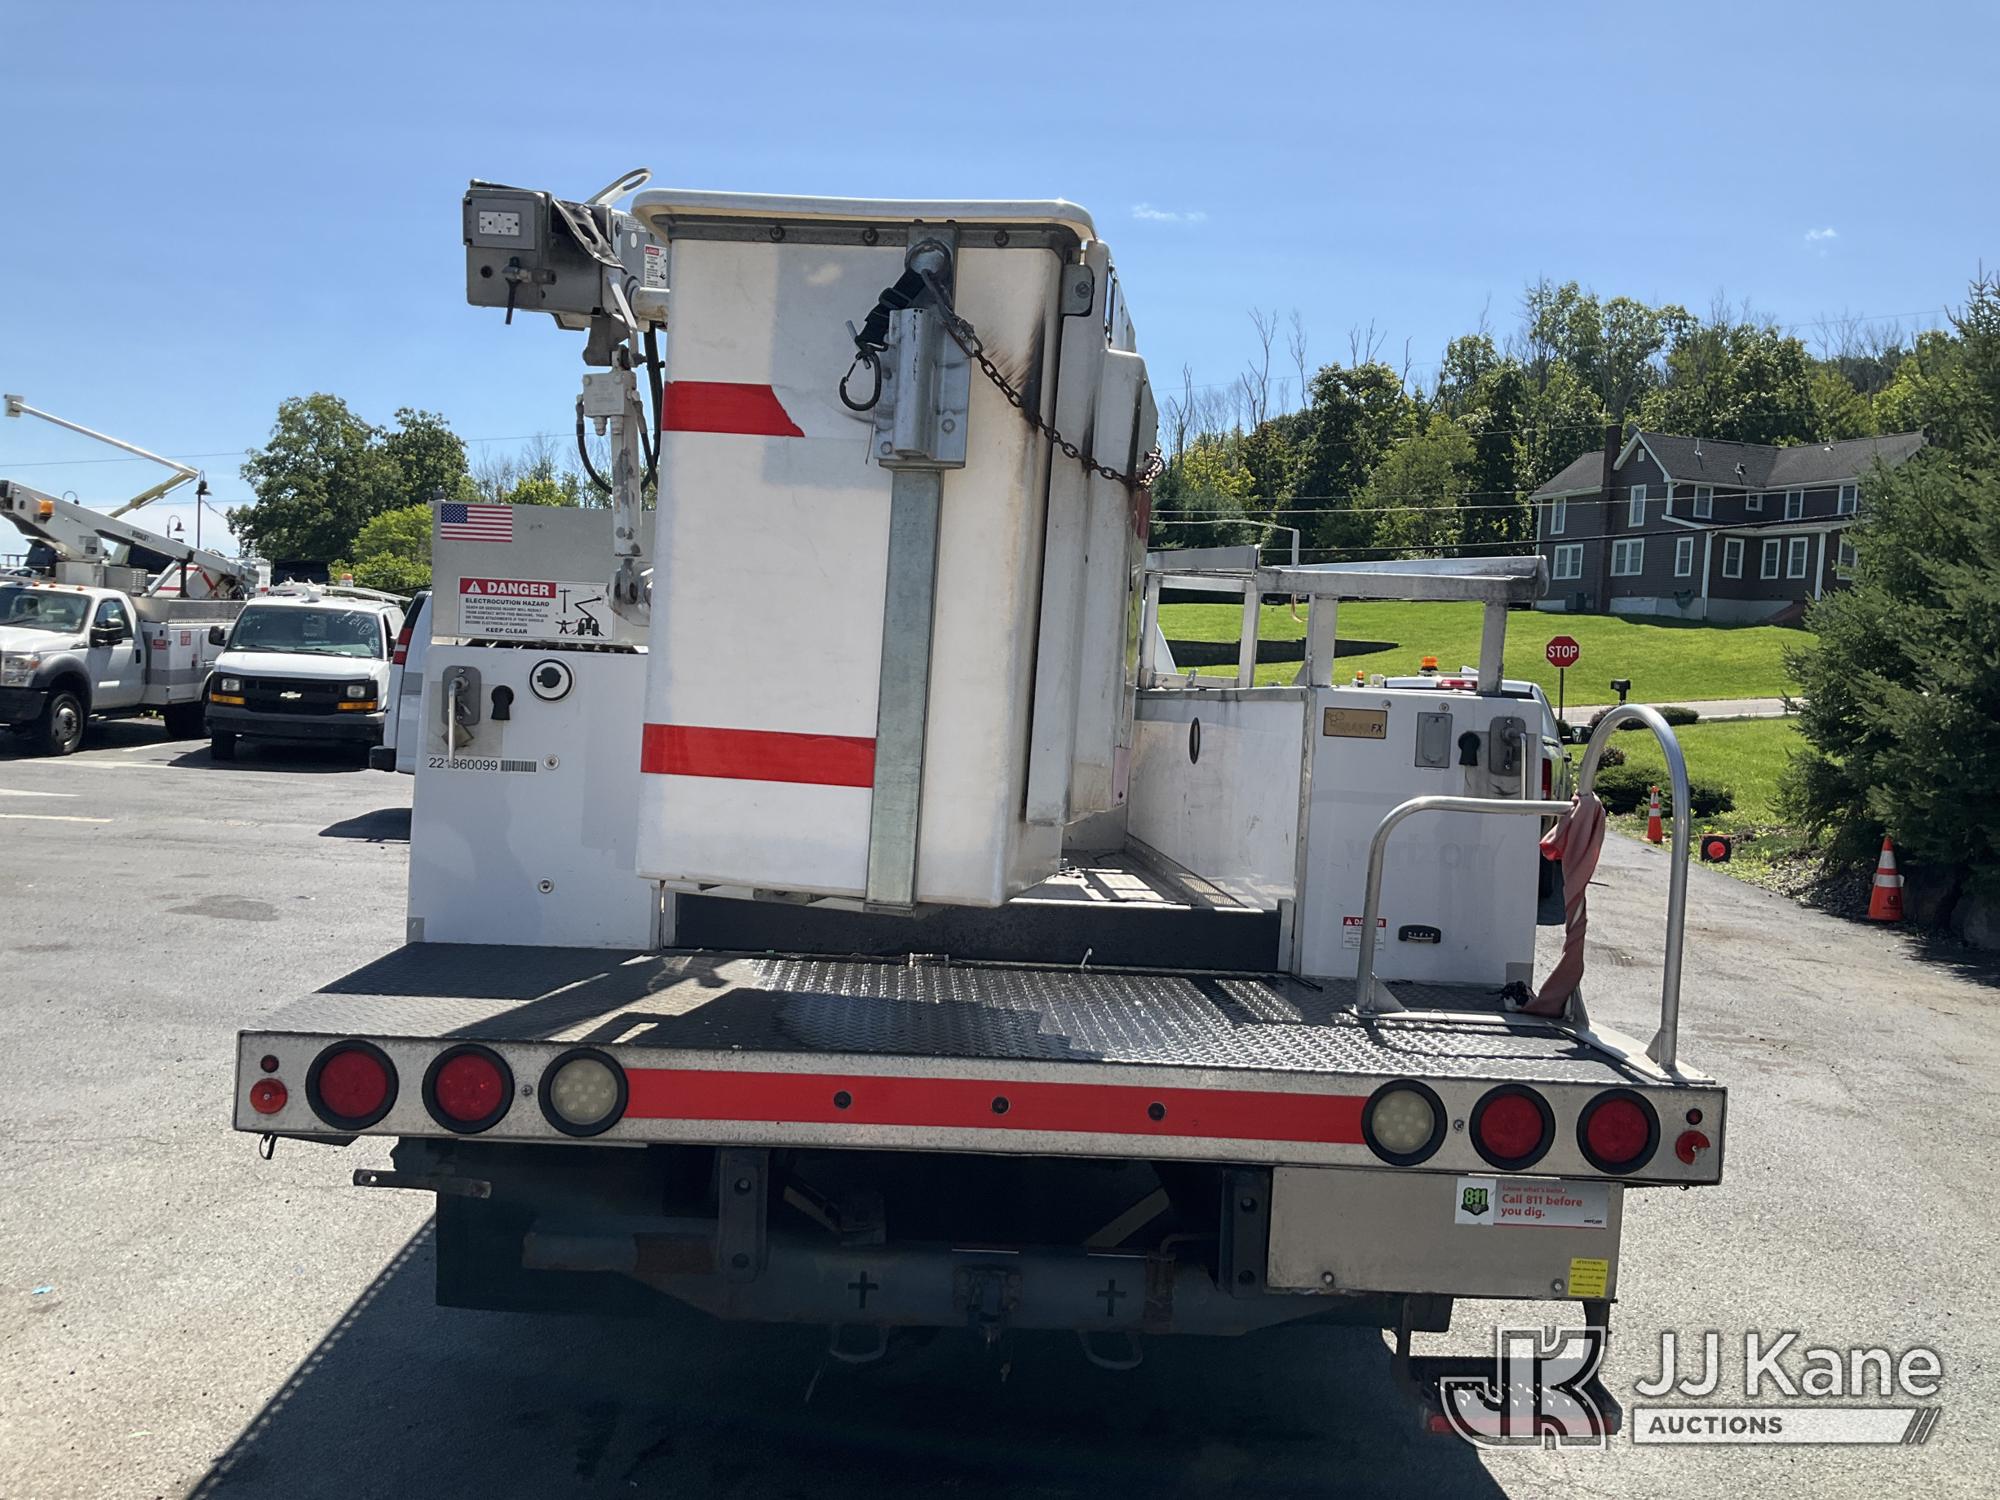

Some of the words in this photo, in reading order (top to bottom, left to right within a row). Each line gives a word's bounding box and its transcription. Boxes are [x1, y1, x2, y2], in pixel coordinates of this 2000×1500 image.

[486, 581, 550, 597] DANGER
[465, 597, 521, 606] ELECTROCUTION
[1547, 645, 1578, 658] STOP
[1464, 1187, 1488, 1206] 811
[1502, 1193, 1523, 1204] Call
[1526, 1195, 1543, 1205] 811
[1545, 1196, 1583, 1207] before
[1501, 1207, 1522, 1217] you
[1524, 1207, 1546, 1218] dig.
